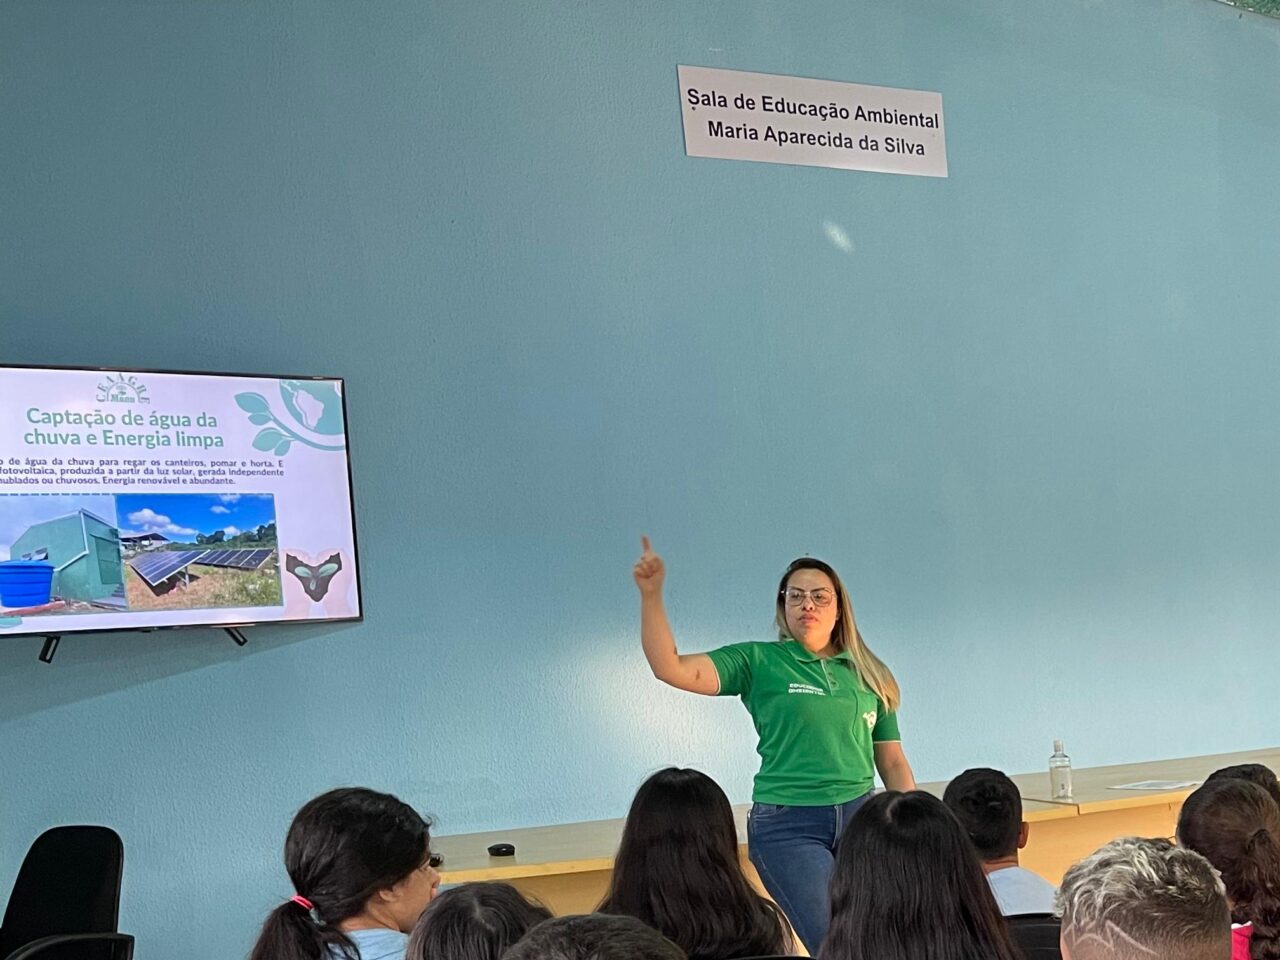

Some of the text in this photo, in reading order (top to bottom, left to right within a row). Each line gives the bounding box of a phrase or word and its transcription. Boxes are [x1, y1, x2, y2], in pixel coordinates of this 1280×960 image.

[687, 88, 939, 129] Sala de Educação Ambiental
[708, 120, 925, 156] Maria Aparecida da Silva
[26, 407, 217, 430] Captação de água da
[23, 429, 224, 450] chuva e Energia limpa
[8, 457, 20, 465] de
[25, 457, 48, 467] água
[52, 457, 63, 465] da
[67, 457, 95, 466] chuva
[99, 459, 119, 467] para
[123, 459, 147, 468] regar
[165, 459, 207, 467] canteiros,
[210, 460, 237, 468] pomar
[250, 459, 275, 467] horta.
[60, 467, 105, 476] produzida
[116, 467, 140, 476] partir
[143, 467, 154, 475] da
[157, 467, 169, 475] luz
[172, 467, 195, 476] solar,
[198, 467, 226, 477] gerada
[228, 467, 284, 477] independente
[56, 476, 101, 484] chuvosos.
[102, 476, 136, 486] Energia
[138, 476, 180, 485] renovável
[189, 476, 236, 485] abundante.
